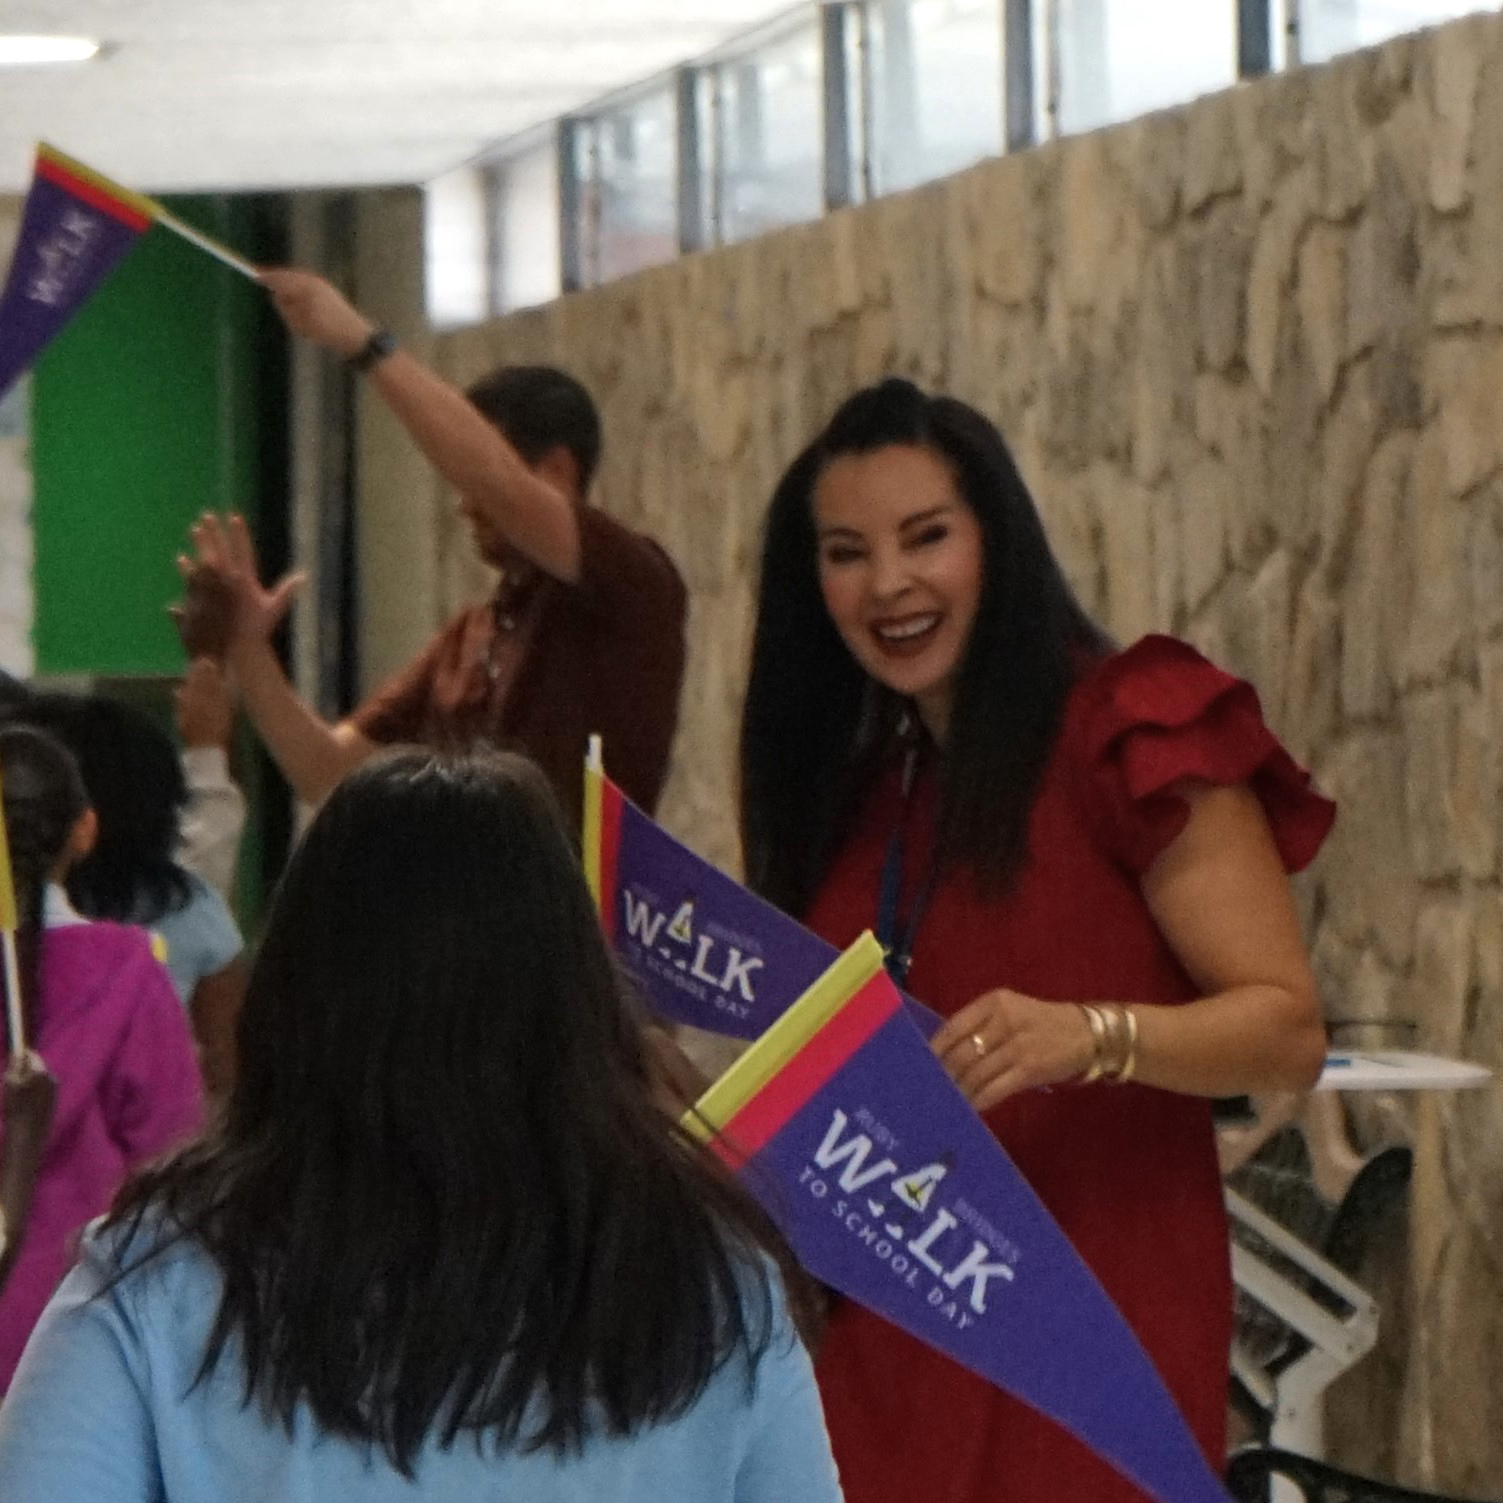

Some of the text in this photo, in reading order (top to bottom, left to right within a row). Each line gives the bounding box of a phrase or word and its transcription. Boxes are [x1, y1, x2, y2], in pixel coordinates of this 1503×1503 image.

[623, 889, 764, 1002] WALK
[797, 1164, 828, 1198] TO
[832, 1199, 920, 1288] SCHOOL
[927, 1286, 974, 1331] DAY
[813, 1108, 1015, 1315] WALK
